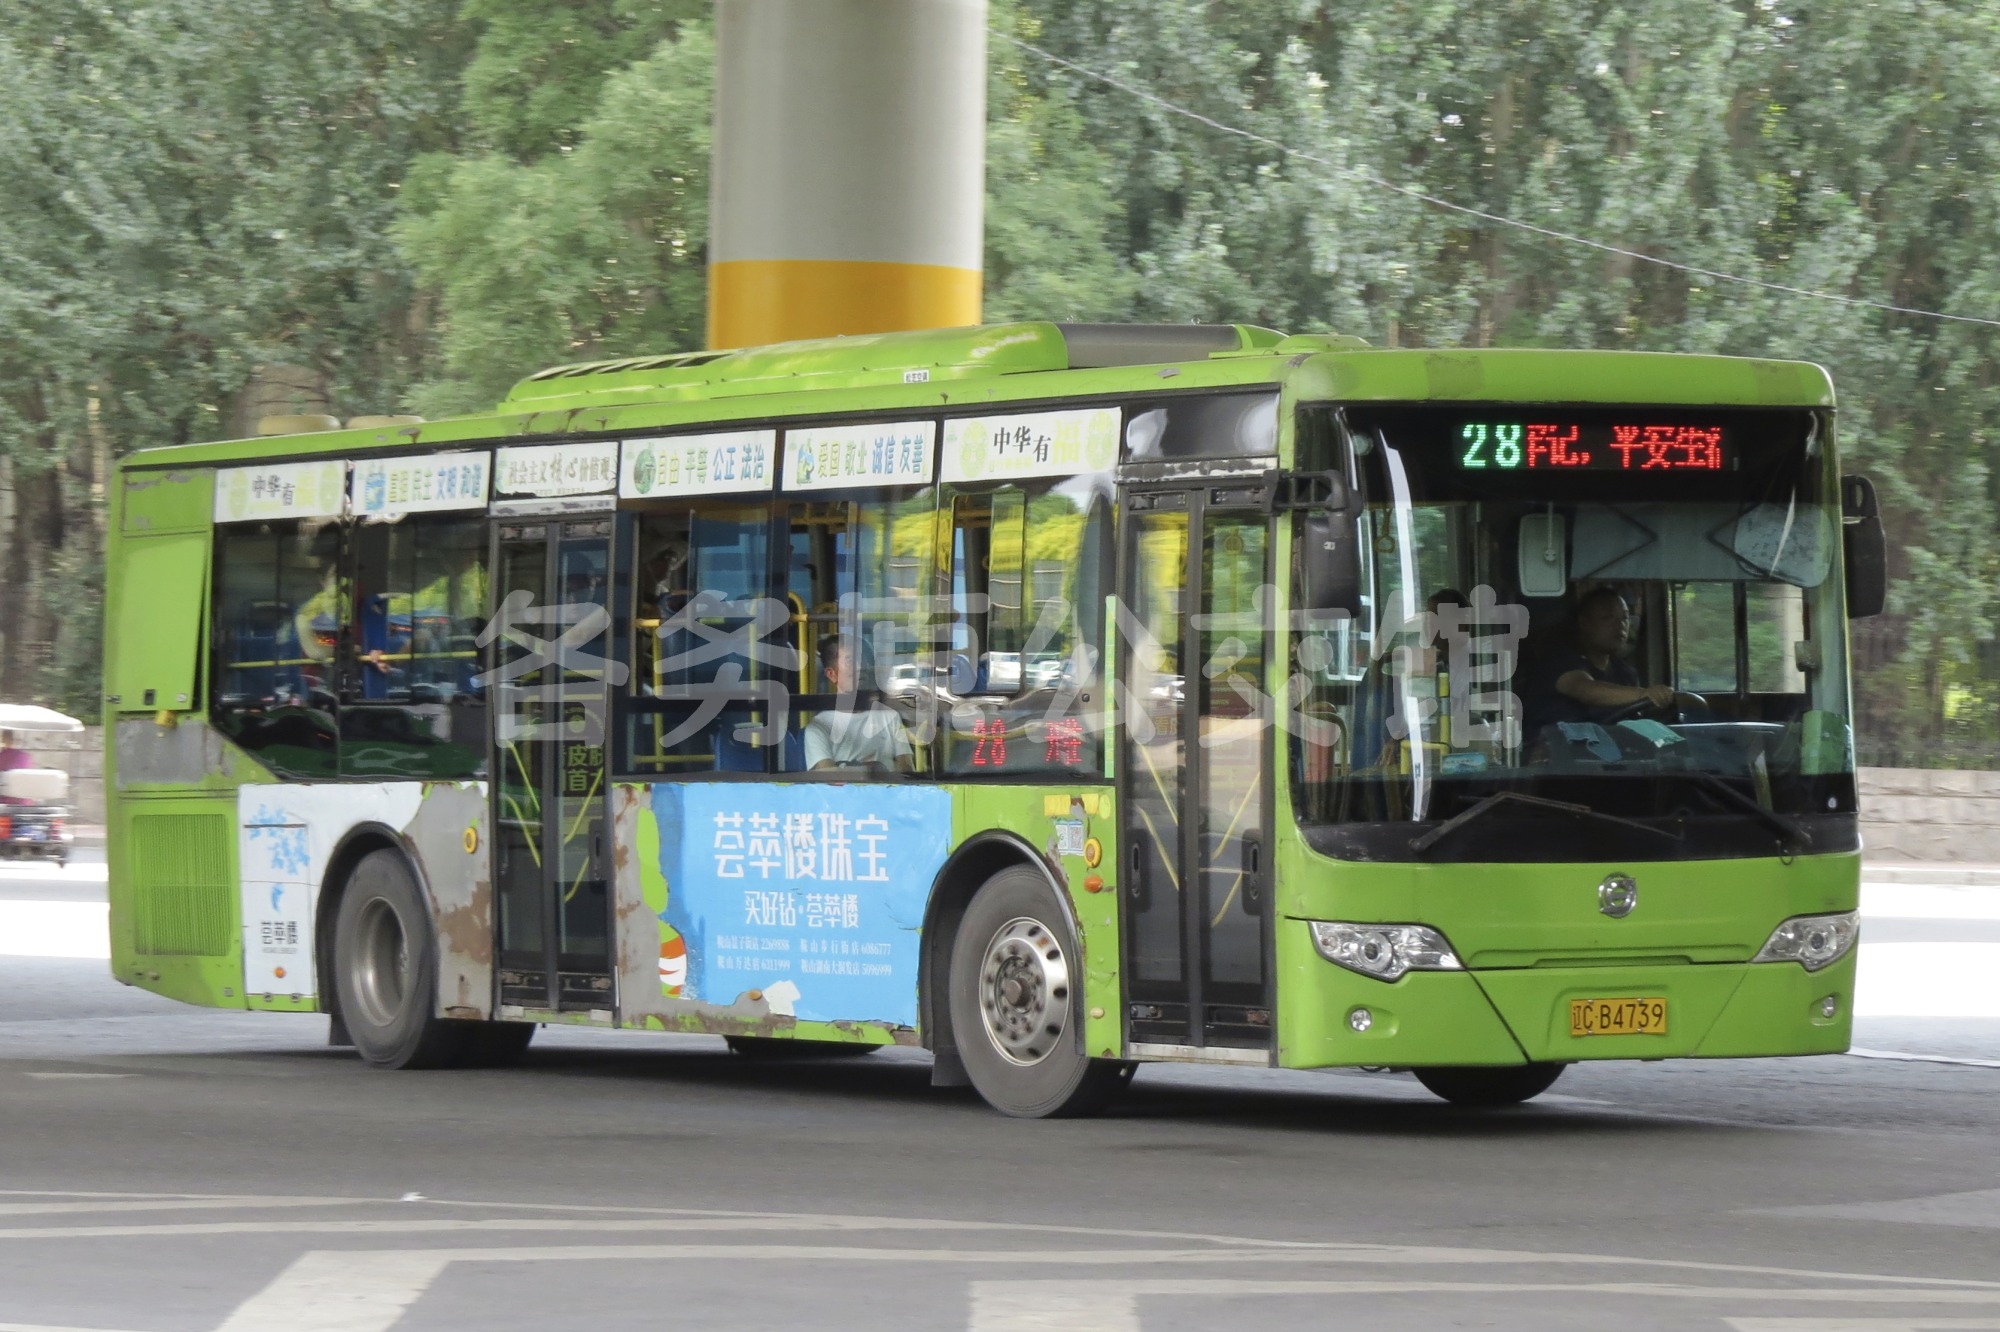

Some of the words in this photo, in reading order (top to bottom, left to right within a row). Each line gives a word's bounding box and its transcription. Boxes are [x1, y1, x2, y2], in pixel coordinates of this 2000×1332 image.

[713, 446, 736, 482] 公正
[741, 443, 764, 480] 法治
[900, 433, 923, 473] 友善
[1462, 424, 1521, 467] 28
[713, 811, 889, 881] 荟萃楼珠宝
